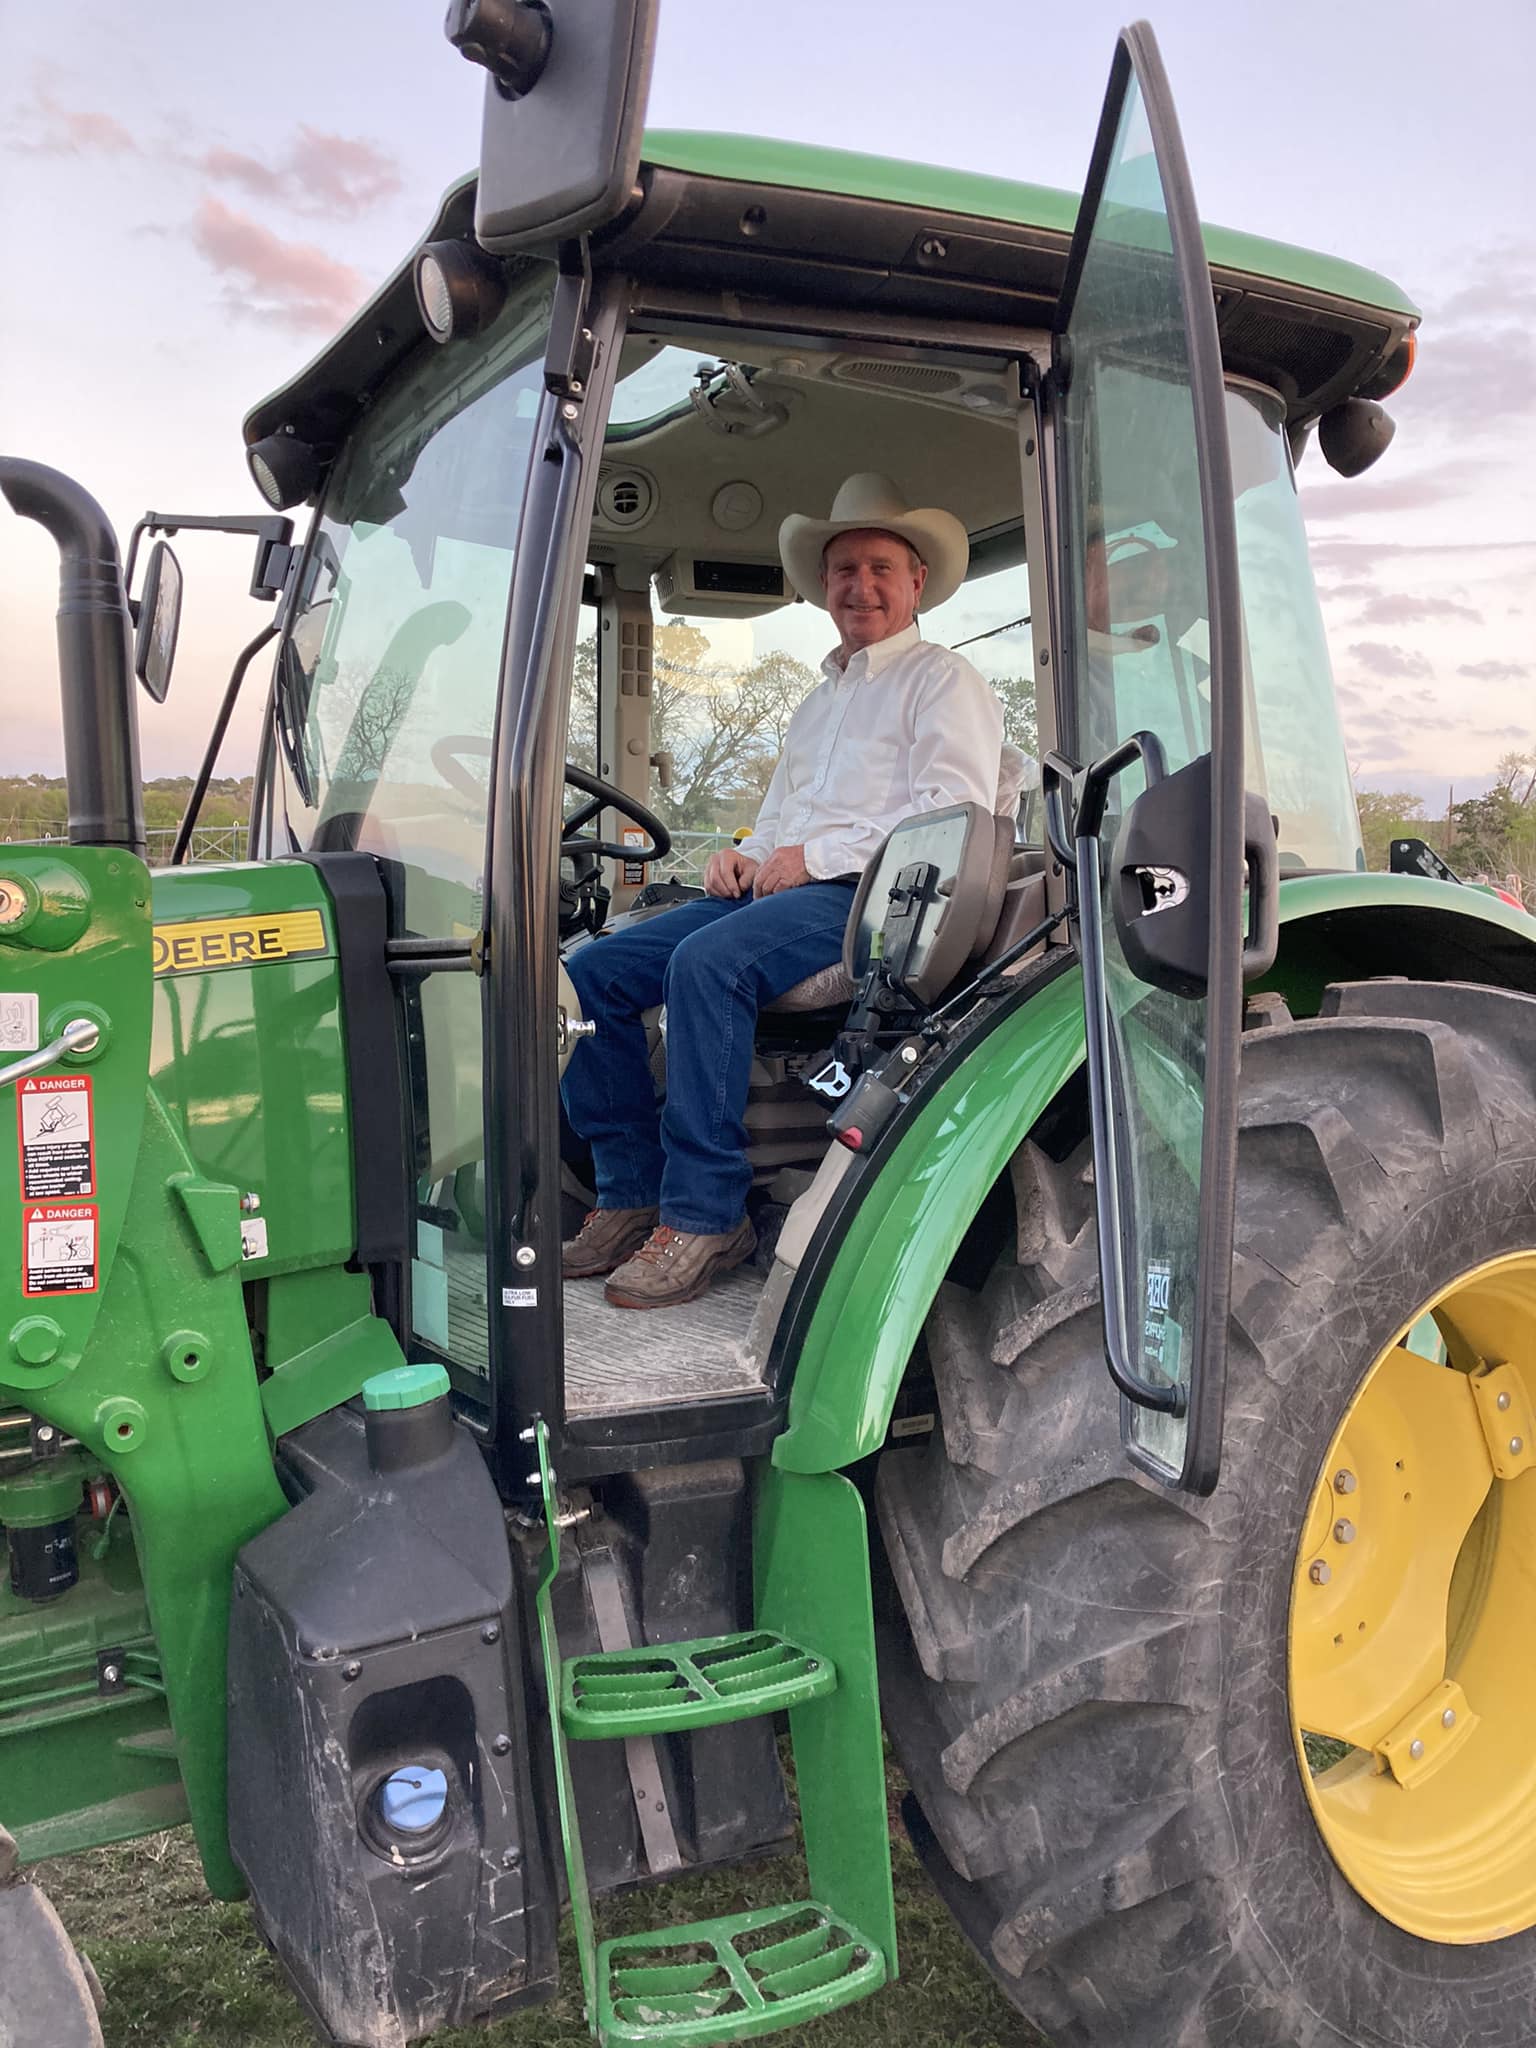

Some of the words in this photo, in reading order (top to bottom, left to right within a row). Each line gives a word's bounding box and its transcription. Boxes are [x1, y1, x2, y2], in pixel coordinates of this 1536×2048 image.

[153, 928, 284, 967] DEERE
[40, 1079, 86, 1090] DANGER
[46, 1208, 93, 1219] DANGER
